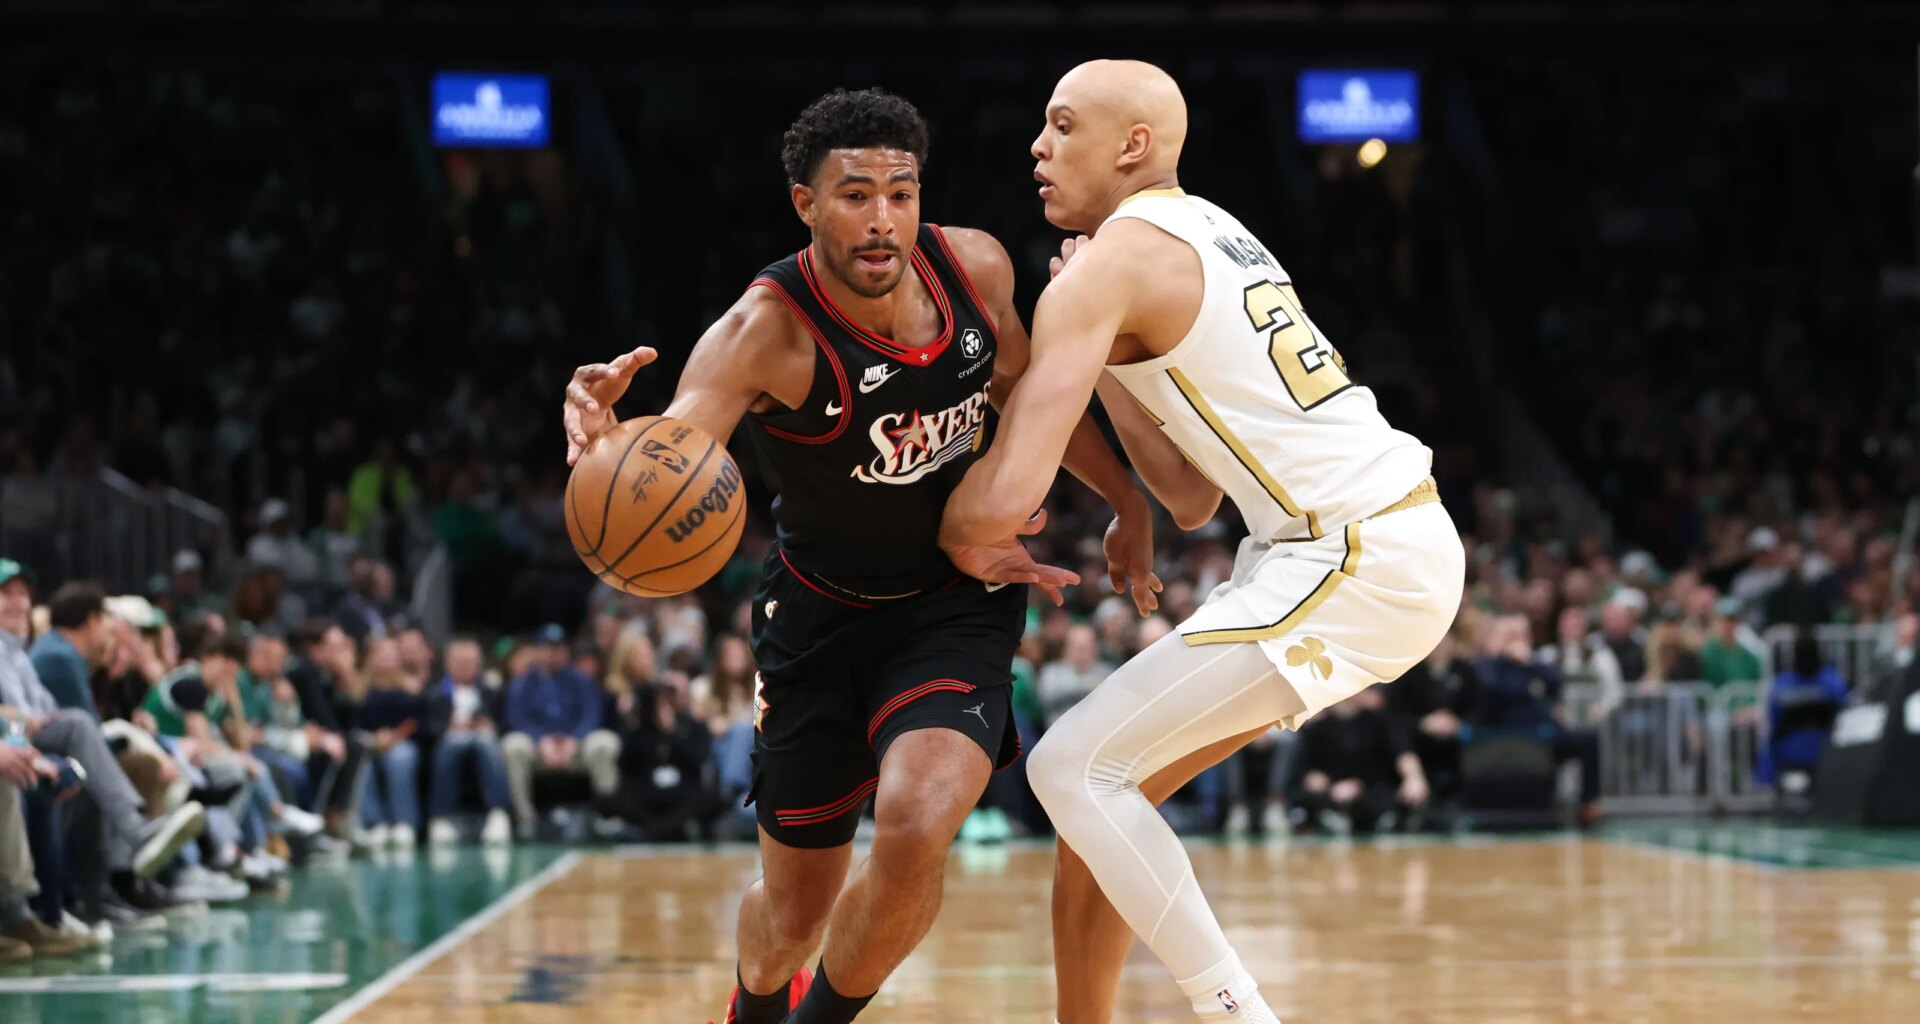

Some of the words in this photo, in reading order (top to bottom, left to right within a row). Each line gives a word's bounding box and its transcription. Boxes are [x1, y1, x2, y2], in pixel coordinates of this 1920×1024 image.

[863, 363, 889, 384] NIKE
[958, 351, 992, 379] crypto.com
[1243, 279, 1353, 412] 2
[664, 454, 741, 543] Wilson
